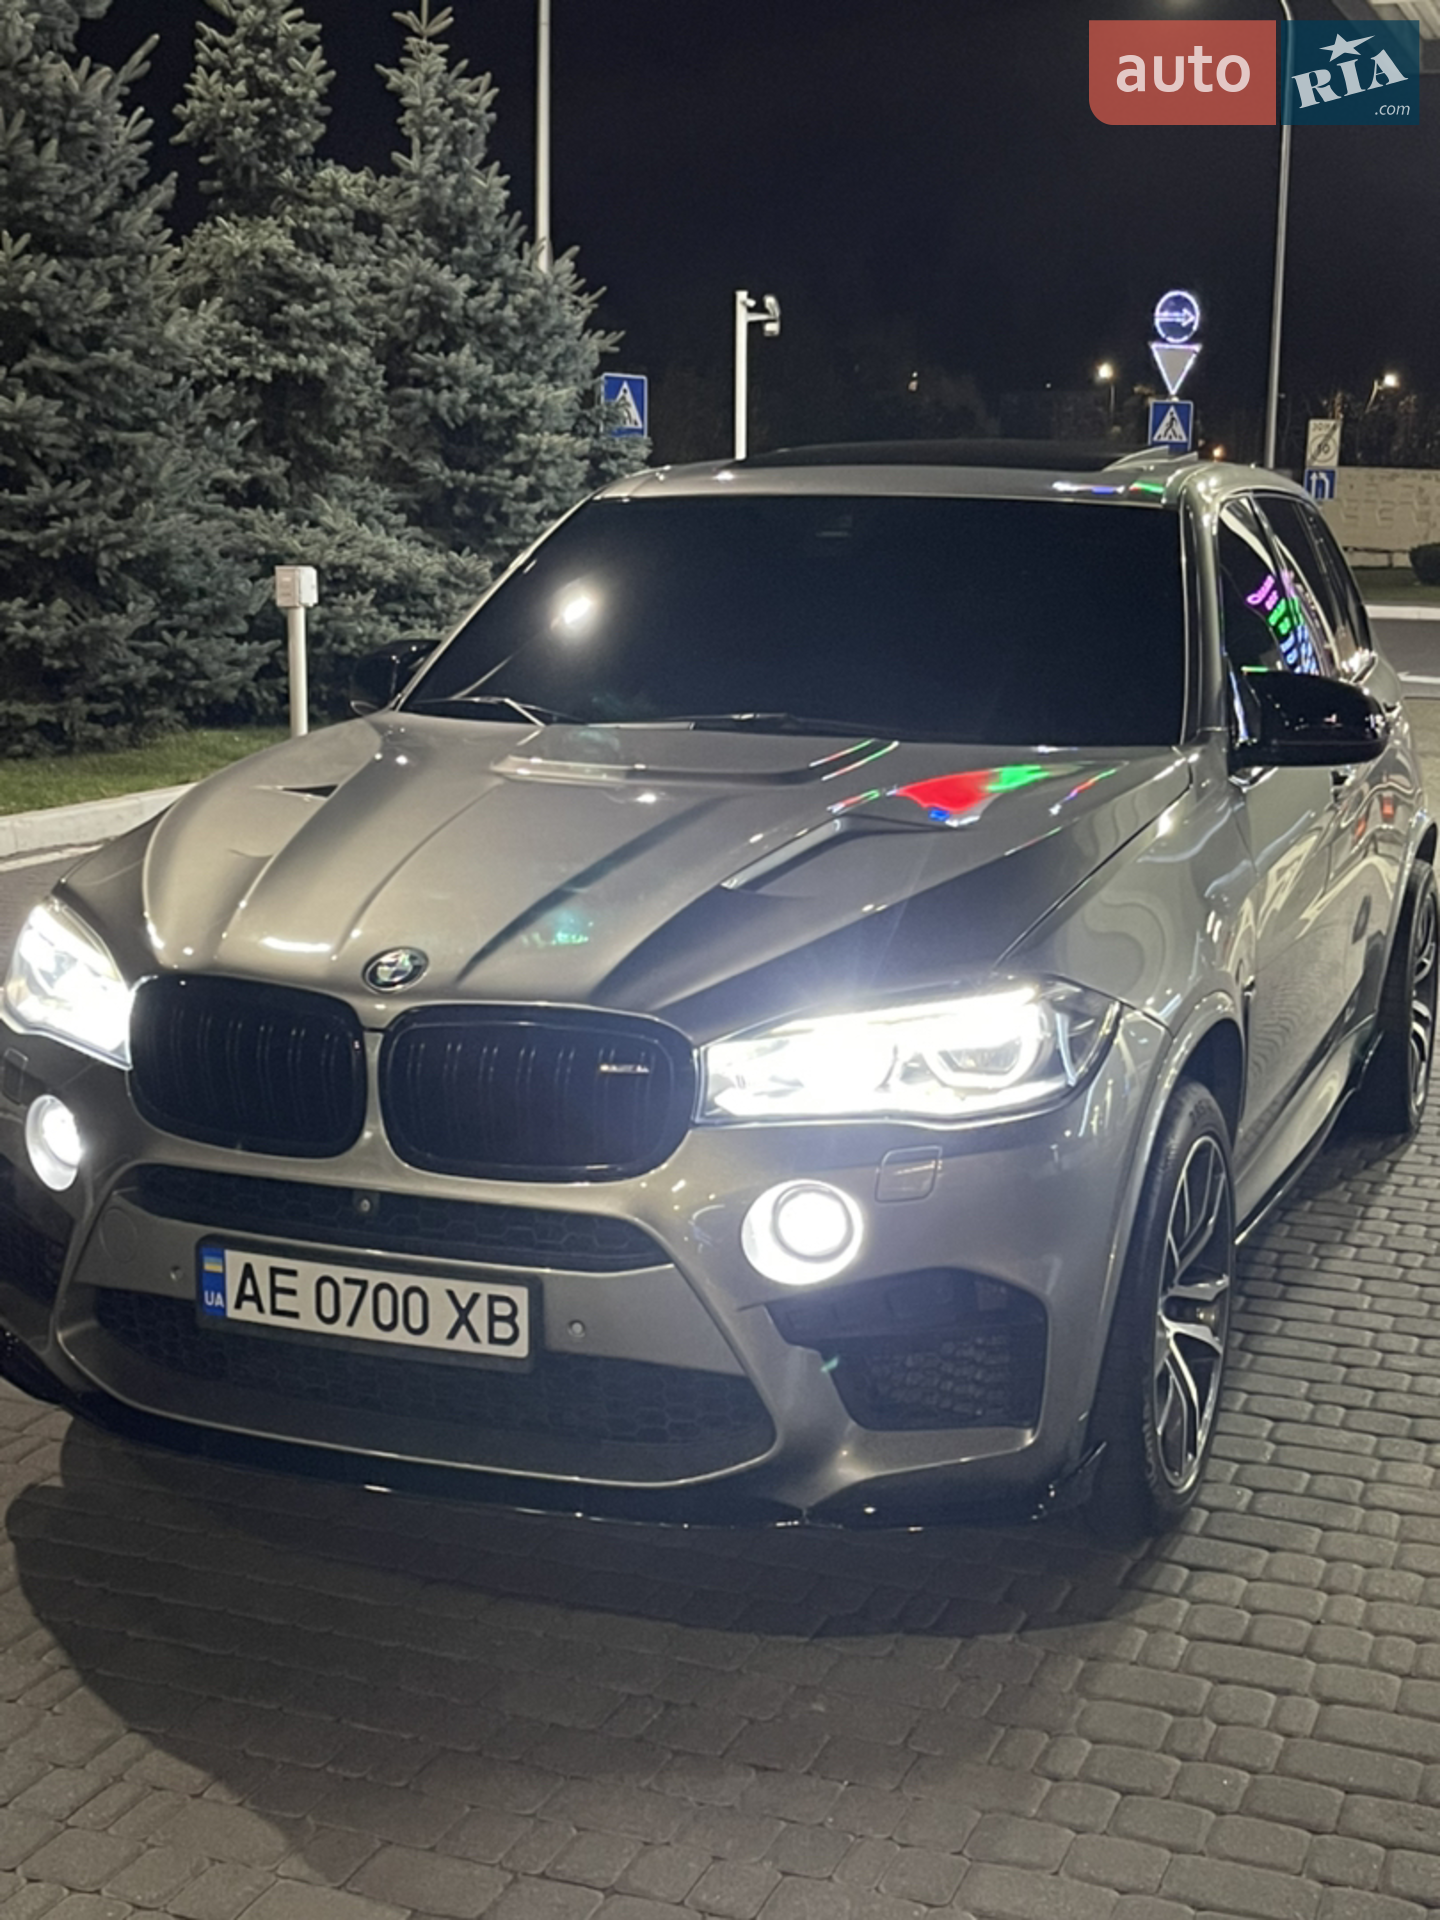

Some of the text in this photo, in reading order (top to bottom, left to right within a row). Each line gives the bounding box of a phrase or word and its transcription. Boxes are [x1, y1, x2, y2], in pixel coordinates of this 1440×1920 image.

[204, 1291, 225, 1308] UA
[234, 1262, 520, 1346] AE 0700 XB
